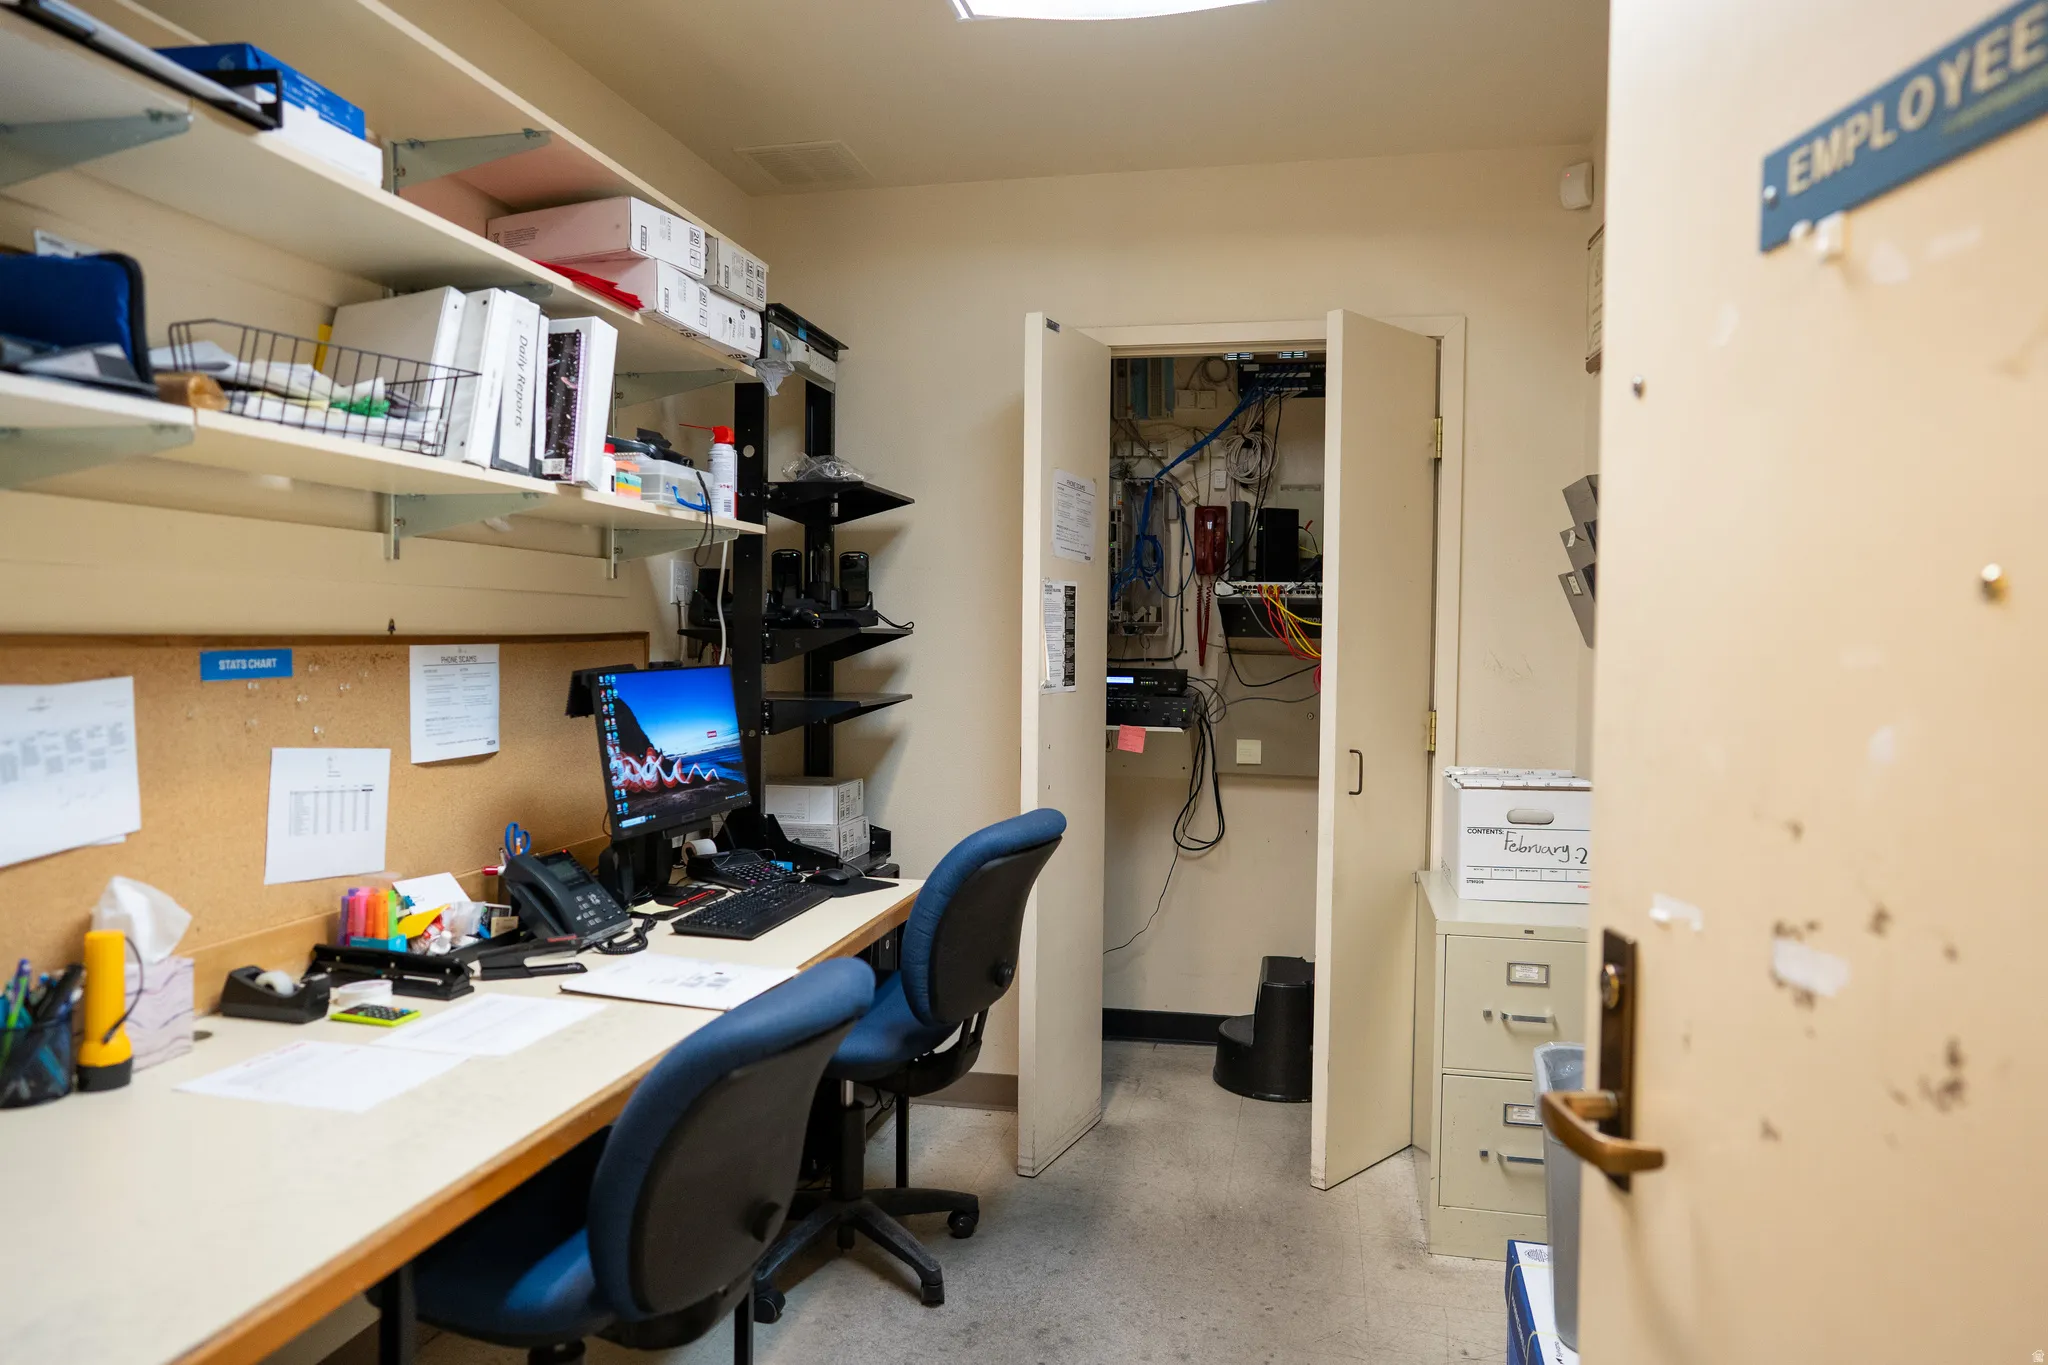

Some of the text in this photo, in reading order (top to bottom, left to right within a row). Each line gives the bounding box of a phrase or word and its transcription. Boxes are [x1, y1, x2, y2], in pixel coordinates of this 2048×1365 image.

[1787, 1, 2048, 196] EMPLOYEE
[515, 335, 528, 428] Daily Reports
[218, 657, 277, 671] STATS CHART
[458, 655, 478, 663] SCAMS
[1504, 831, 1570, 863] February
